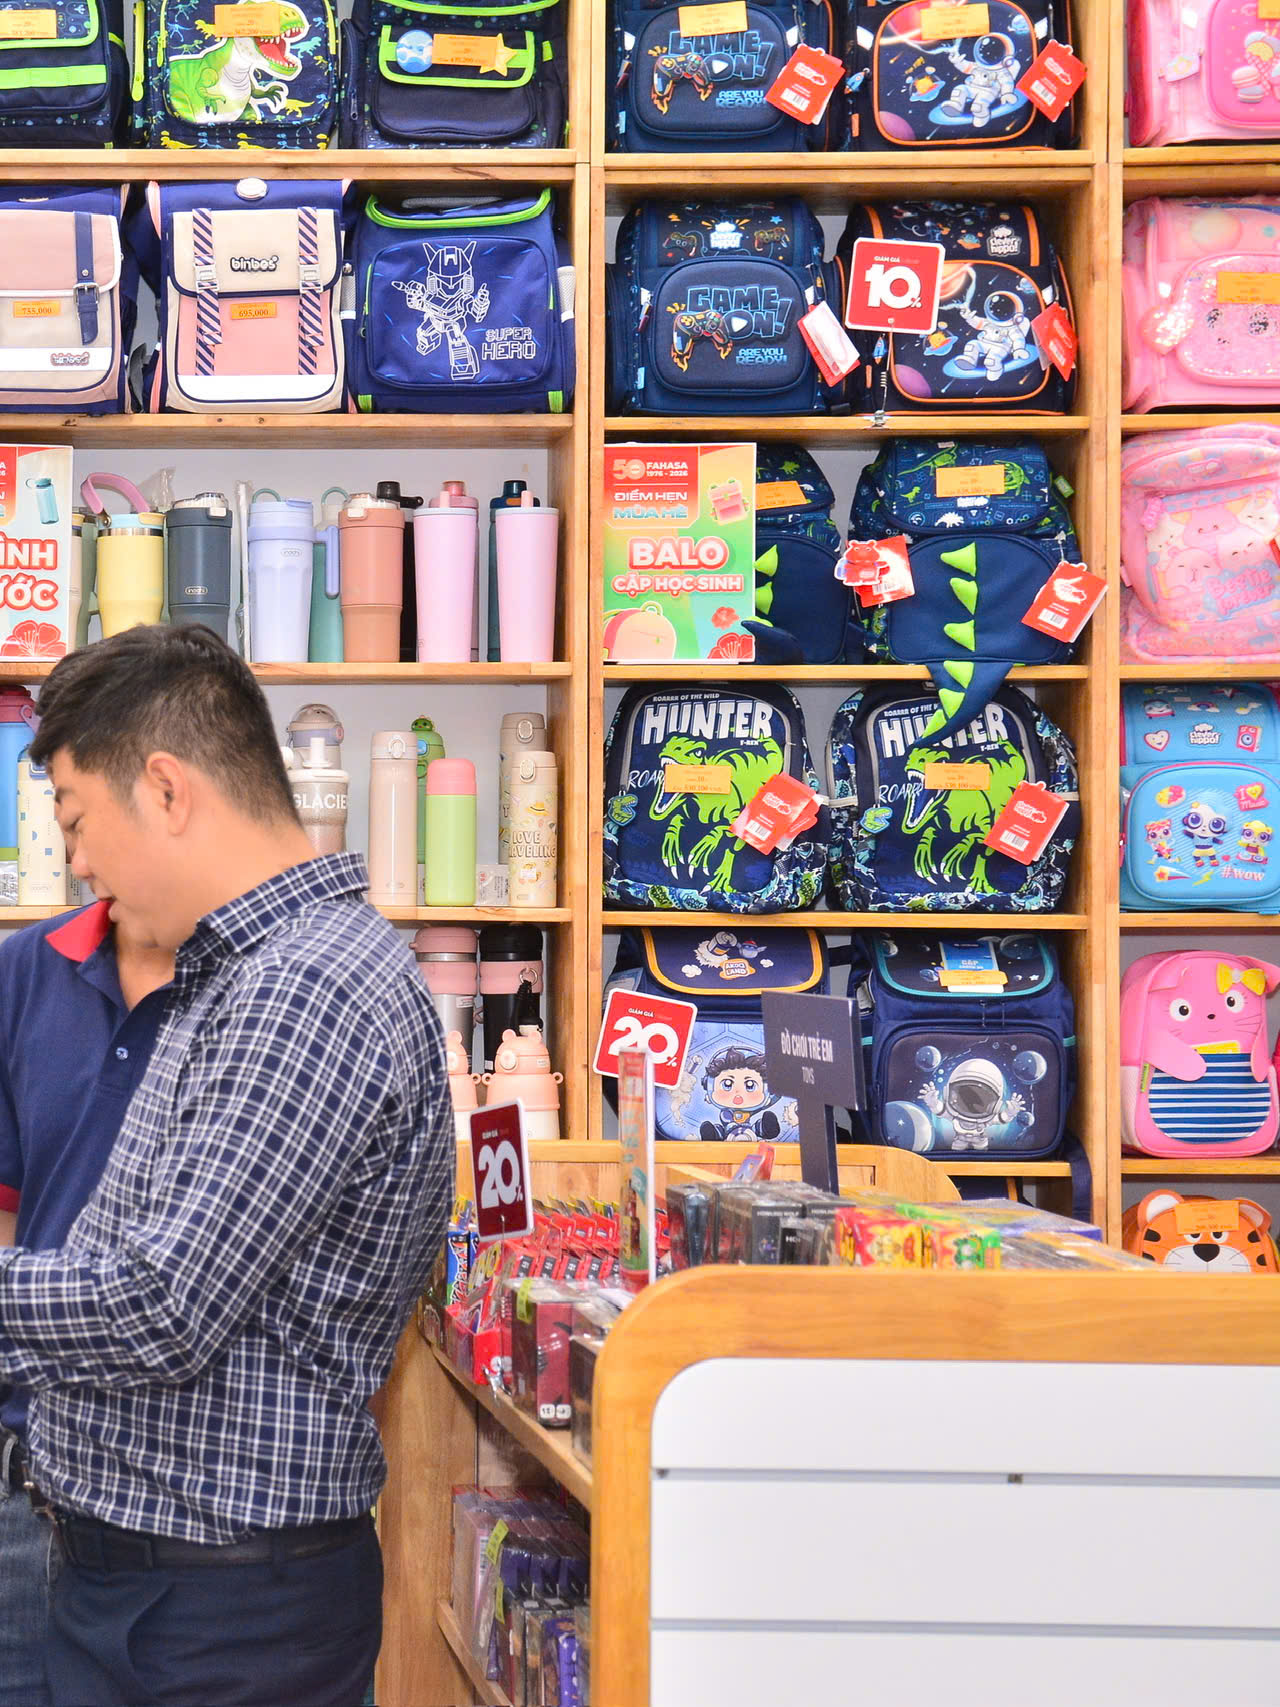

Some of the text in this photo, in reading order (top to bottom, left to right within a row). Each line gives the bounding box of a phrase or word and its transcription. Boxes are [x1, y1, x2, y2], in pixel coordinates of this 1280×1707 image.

[741, 90, 764, 99] YOU
[865, 263, 922, 309] 10%
[686, 286, 780, 312] GAME
[486, 327, 533, 342] SUPER
[482, 341, 536, 360] HERO
[762, 348, 784, 356] YOU
[613, 458, 689, 480] 50 FAHASA
[614, 488, 688, 504] ĐIỂM HẸN
[613, 504, 688, 519] MÙA HÈ
[630, 539, 727, 568] BALO
[613, 573, 742, 596] CẶP HỌC SINH
[641, 700, 773, 745] HUNTER
[980, 744, 1000, 752] T-REX
[512, 831, 541, 845] LOVE
[628, 1007, 654, 1018] GIẢM GIÁ
[608, 1015, 680, 1068] 20%
[808, 1031, 822, 1061] TRẺ
[822, 1041, 834, 1063] EM
[478, 1140, 524, 1209] 20%
